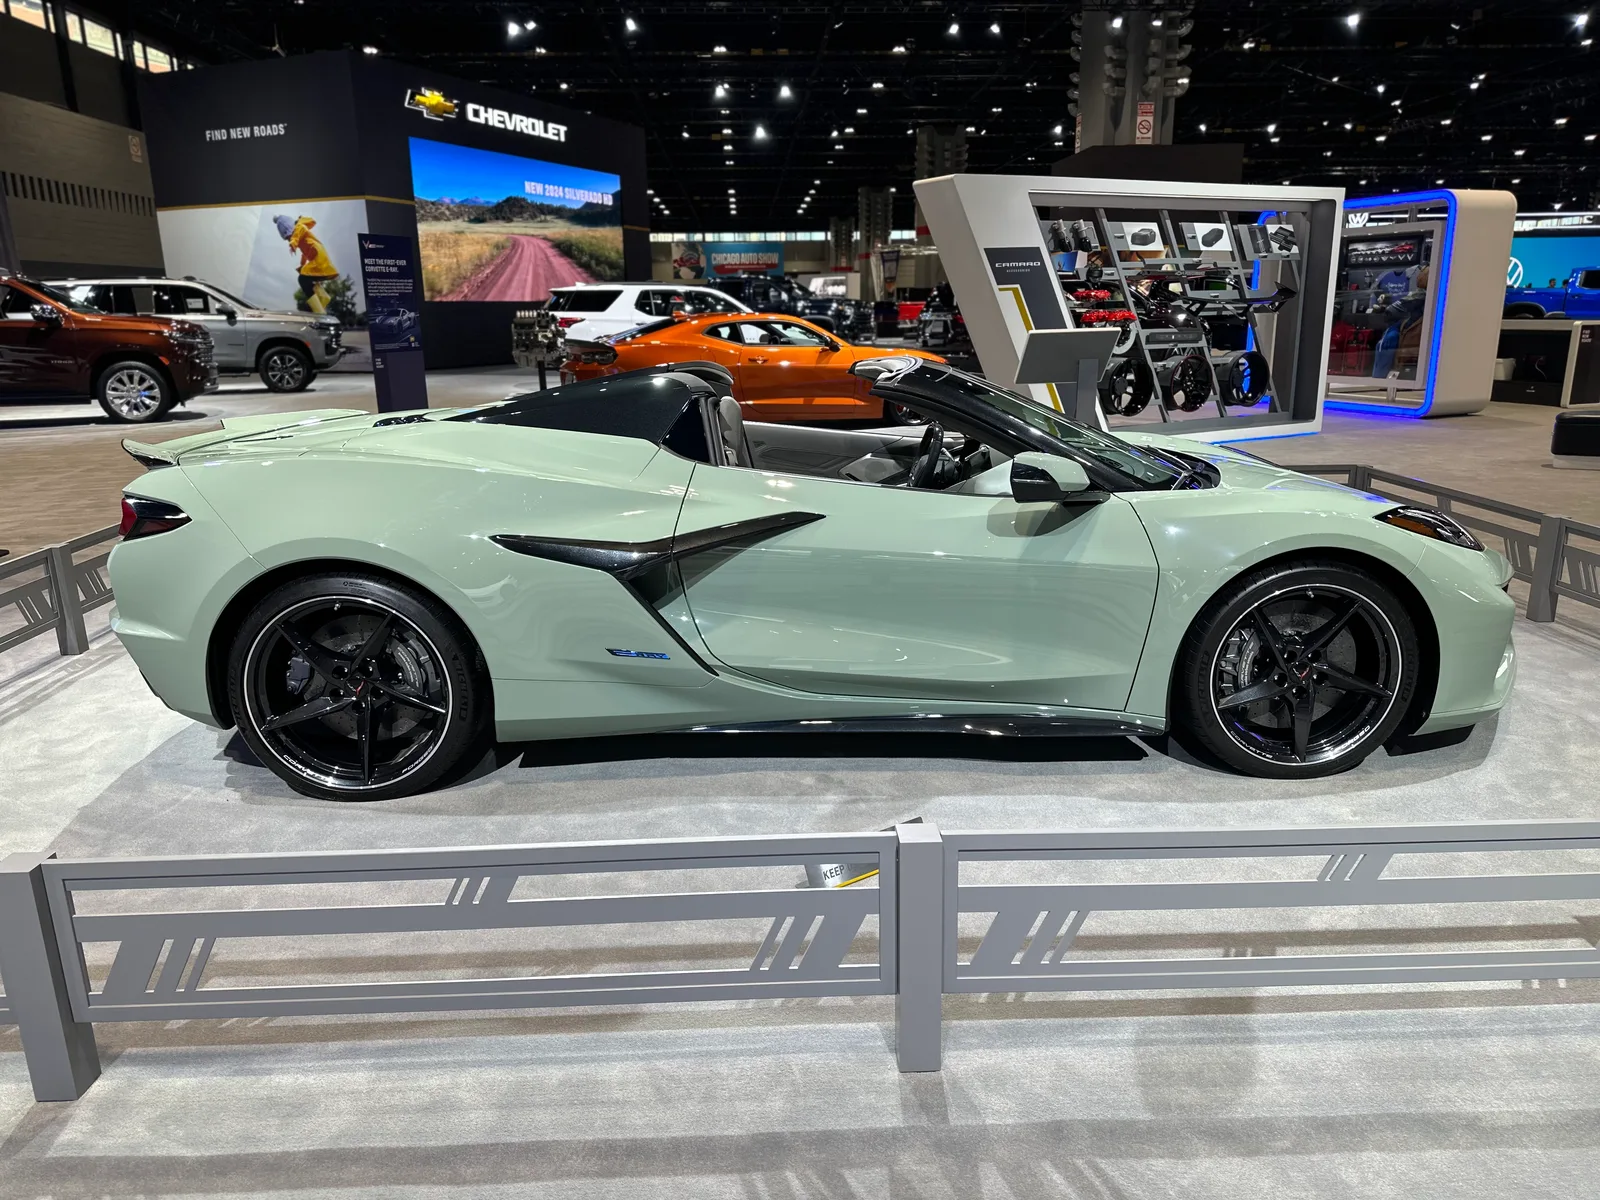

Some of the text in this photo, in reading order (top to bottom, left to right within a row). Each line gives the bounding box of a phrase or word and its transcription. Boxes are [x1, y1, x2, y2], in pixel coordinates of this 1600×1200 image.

[465, 102, 568, 142] CHEVROLET
[205, 129, 228, 141] FIND
[229, 126, 251, 139] NEW
[524, 180, 544, 196] NEW
[544, 183, 564, 199] 2024
[564, 186, 602, 204] SILVERADO
[711, 252, 779, 265] CHICAGO AUTO SHOW
[822, 865, 845, 881] KEEP
